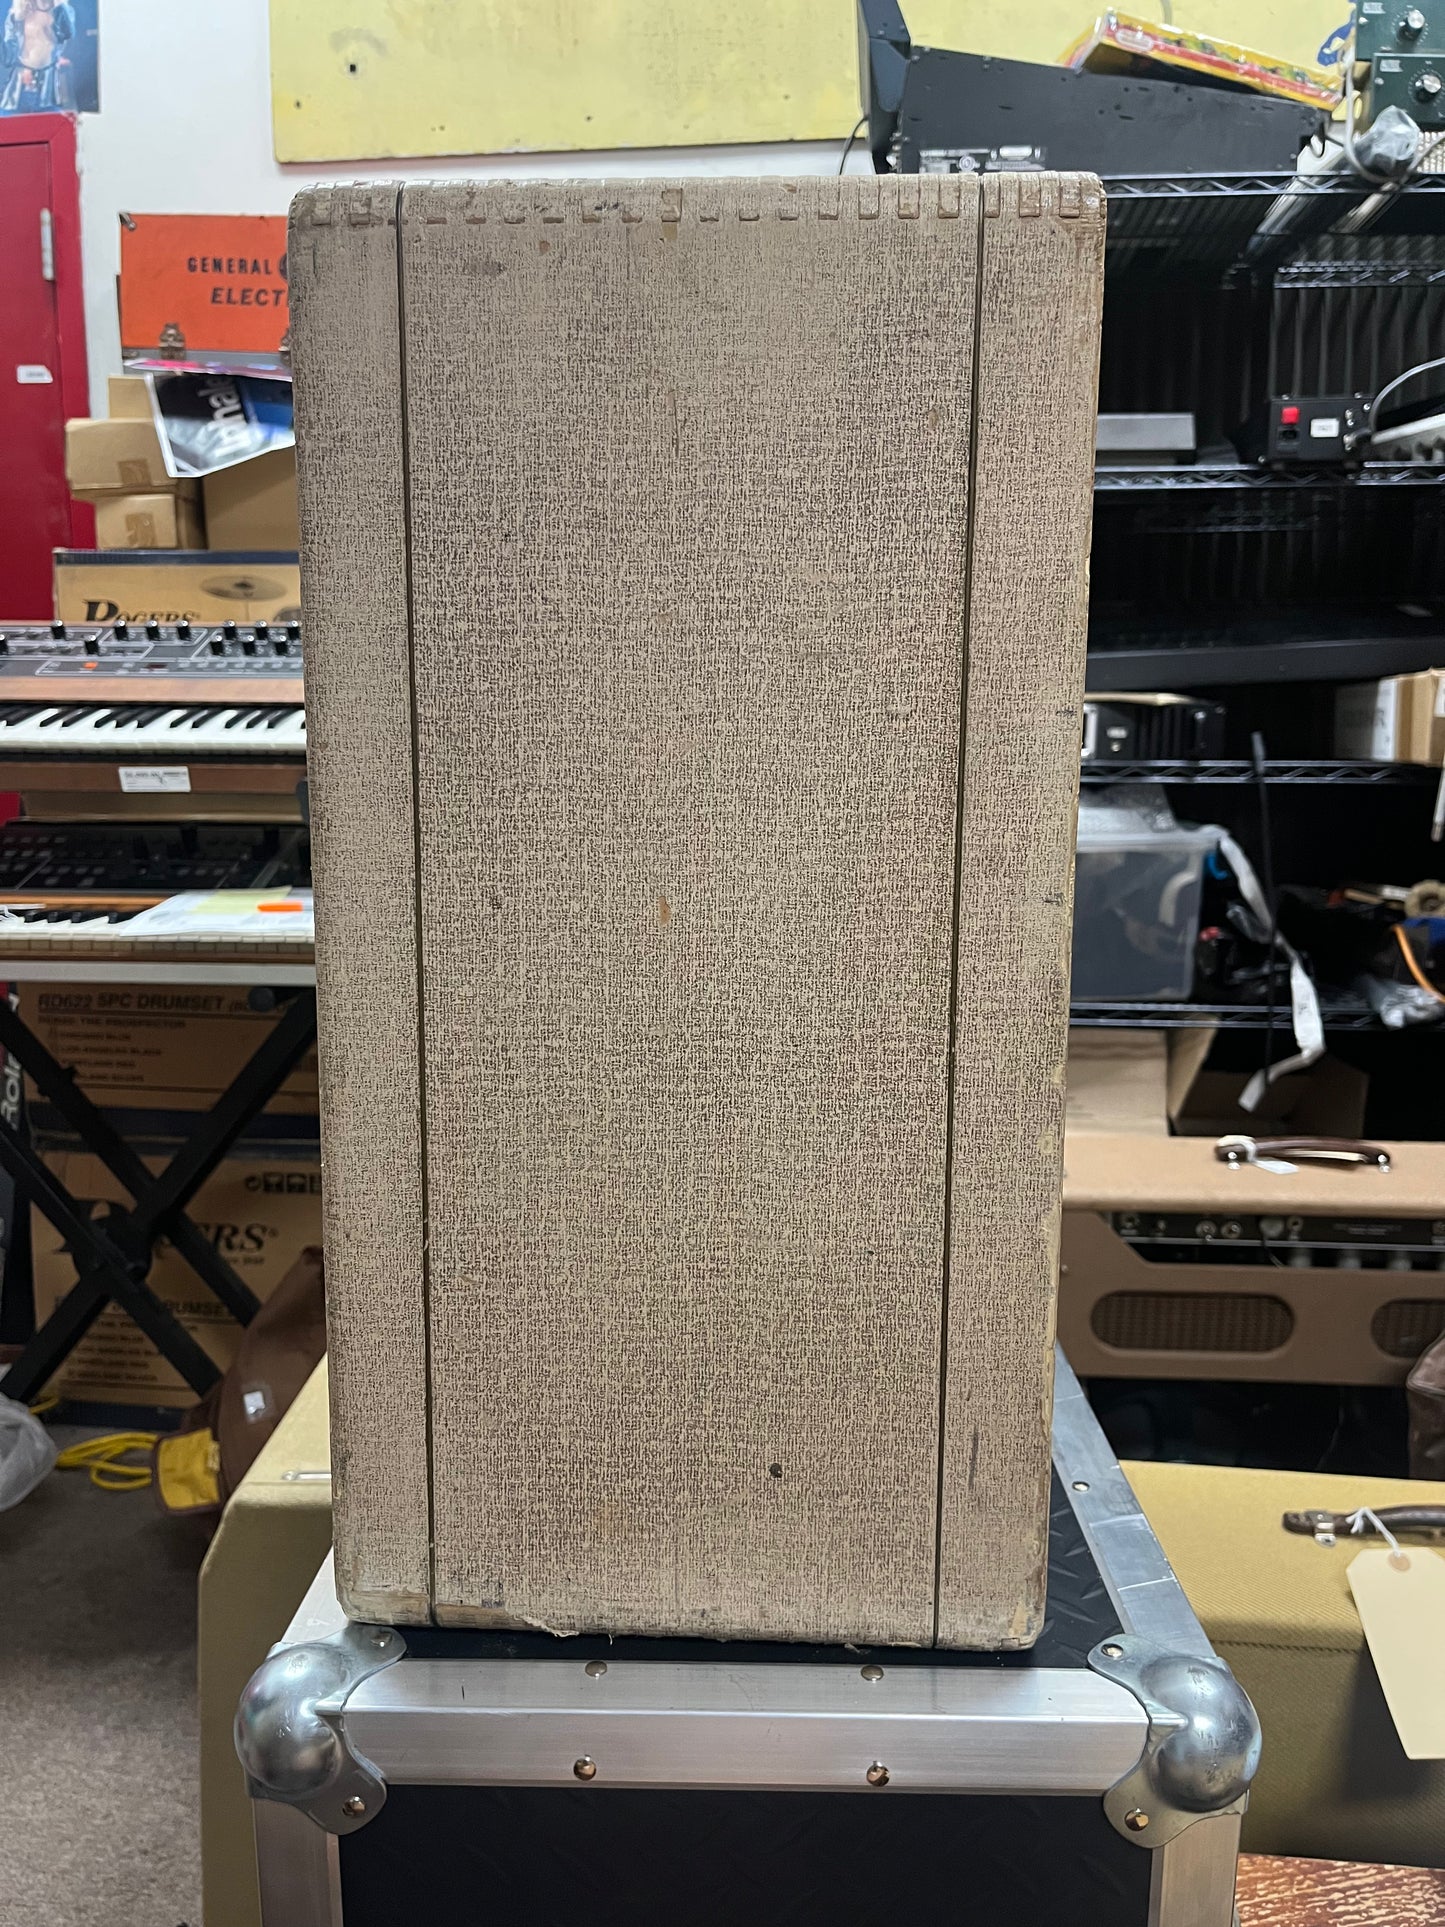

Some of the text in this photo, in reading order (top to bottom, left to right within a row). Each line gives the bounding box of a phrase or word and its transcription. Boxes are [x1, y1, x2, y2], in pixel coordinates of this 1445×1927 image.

[187, 256, 273, 275] GENERAL
[210, 286, 288, 307] ELECT
[137, 993, 225, 1012] DRUMSET
